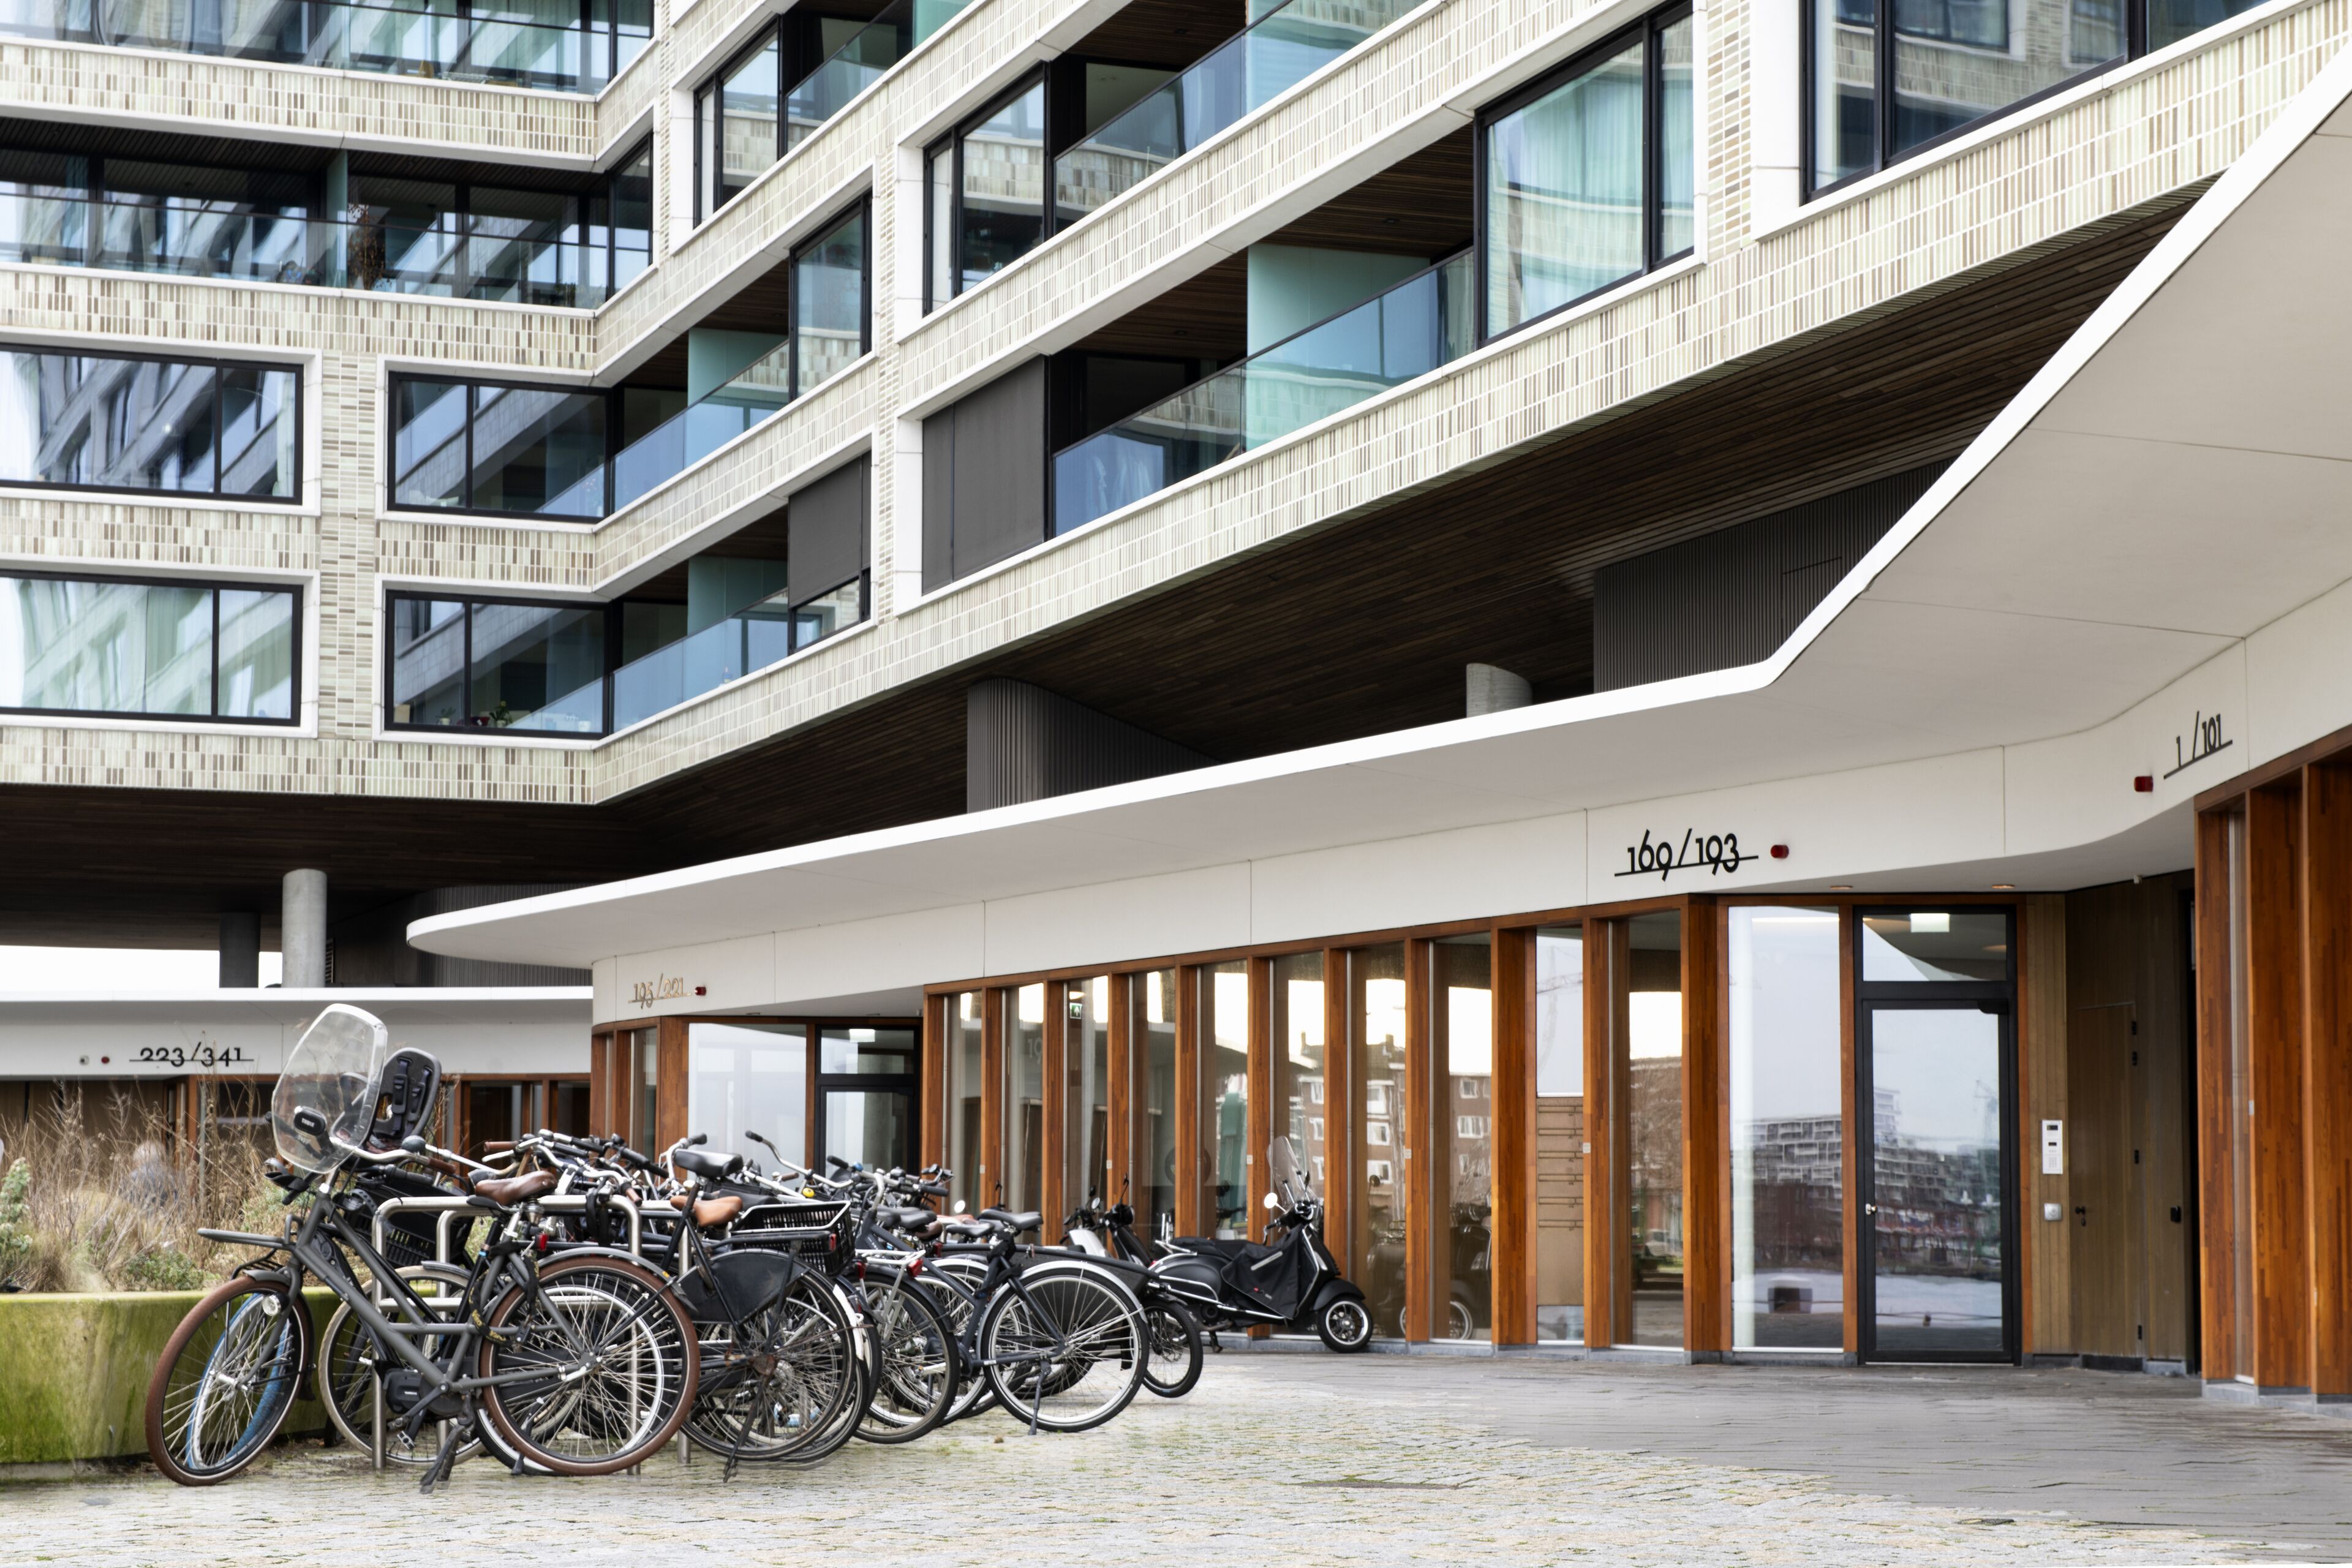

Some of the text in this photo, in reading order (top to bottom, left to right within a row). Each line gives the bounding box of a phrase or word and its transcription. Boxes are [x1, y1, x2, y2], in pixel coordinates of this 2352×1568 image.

[1627, 827, 1740, 882] 169/193
[633, 973, 684, 1010] 195/221
[140, 1041, 241, 1067] 223/341
